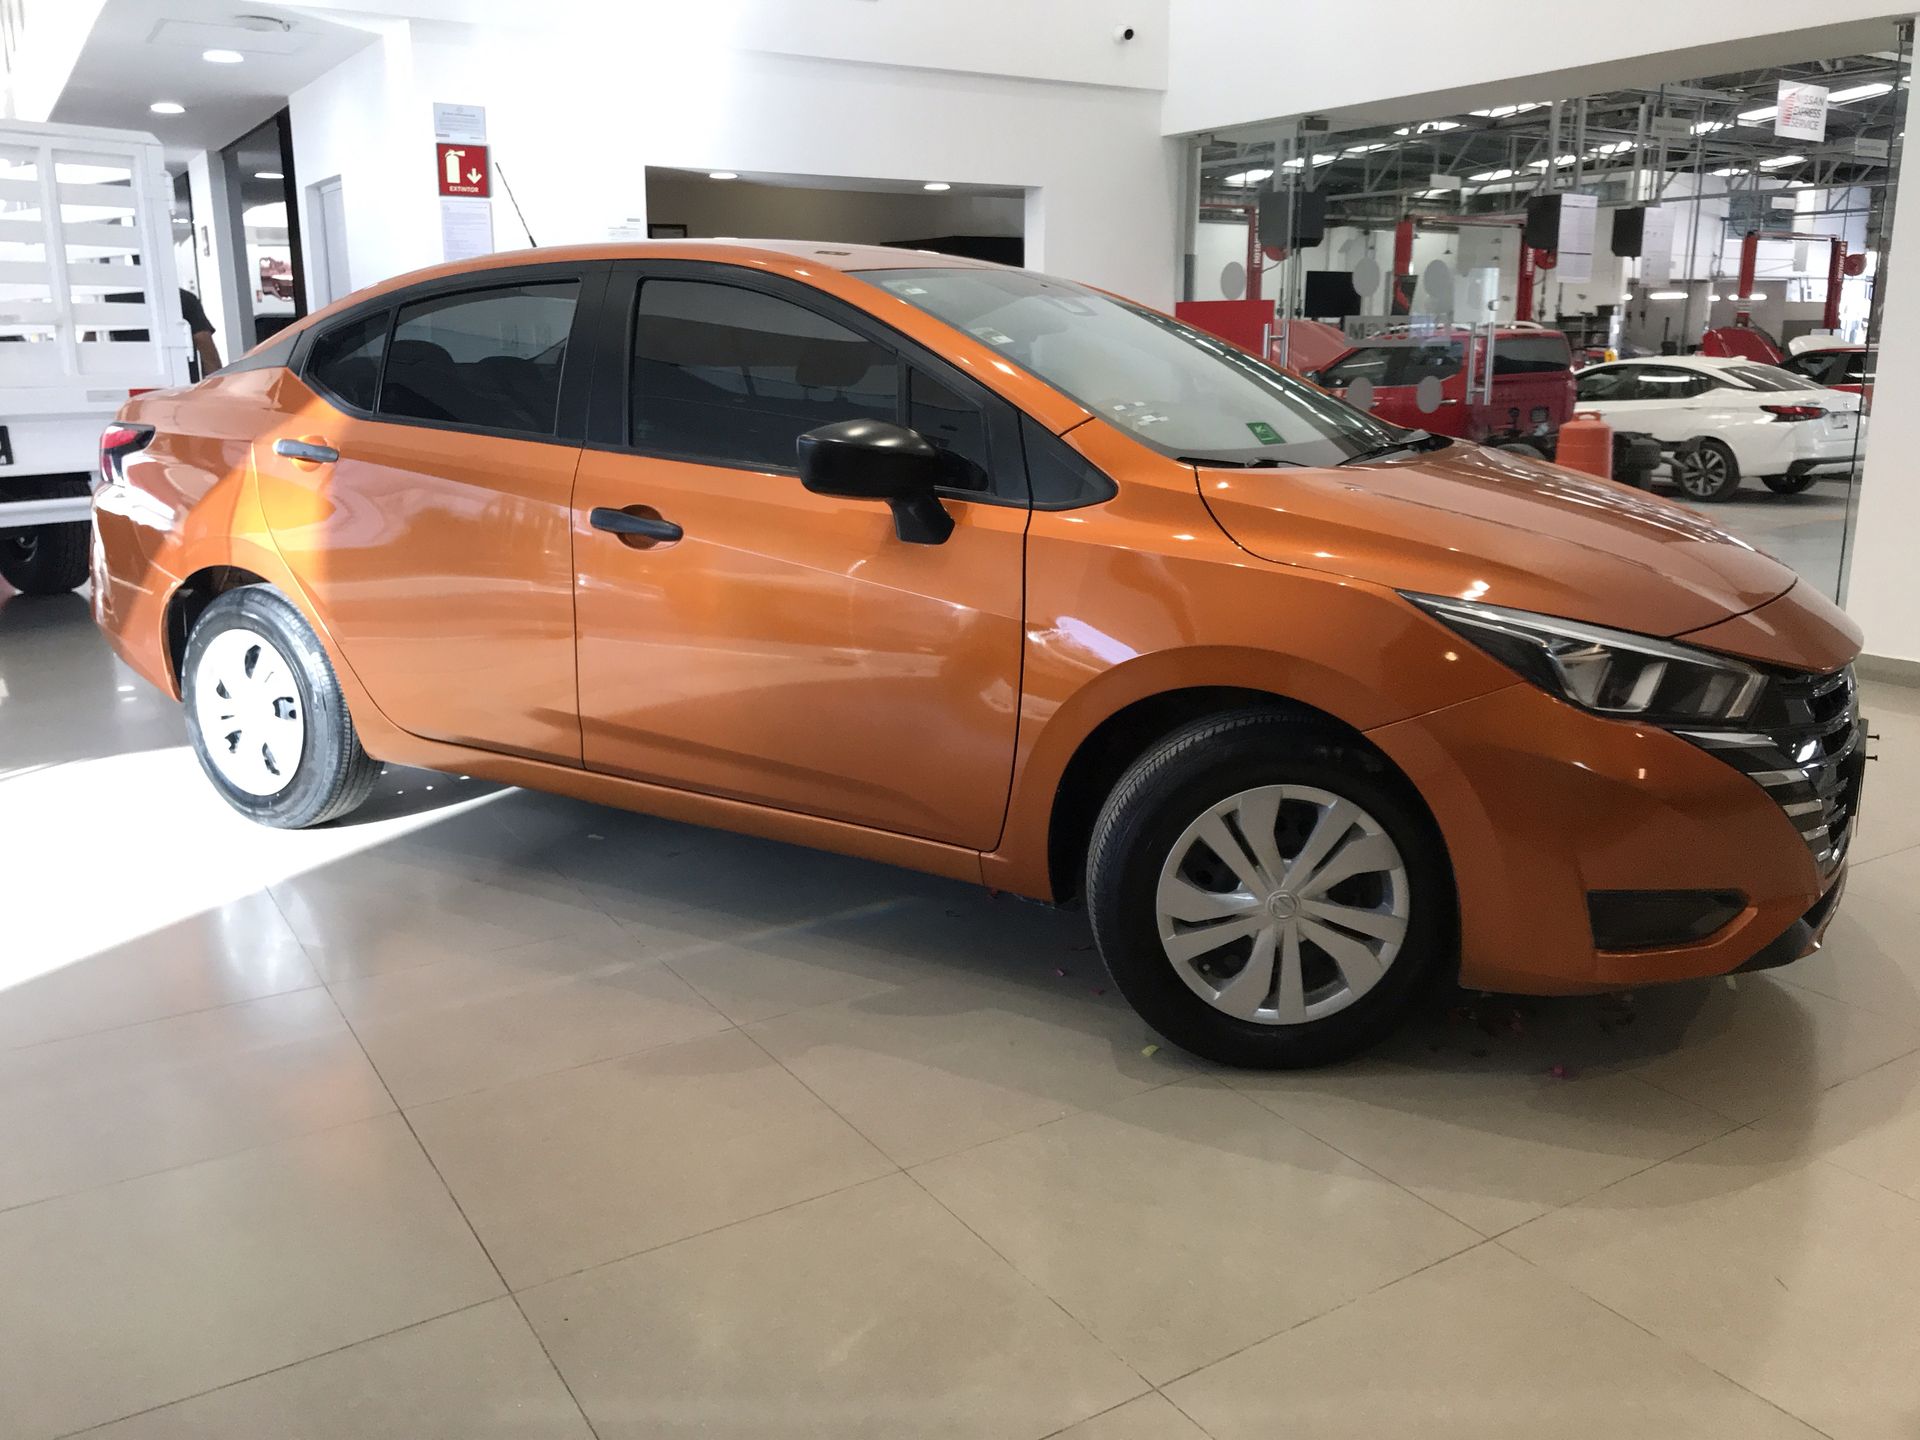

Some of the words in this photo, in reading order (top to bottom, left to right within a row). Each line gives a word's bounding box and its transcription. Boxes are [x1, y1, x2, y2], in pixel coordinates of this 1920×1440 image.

[1793, 105, 1822, 118] EXPRESS
[1790, 117, 1819, 130] SERVICE
[449, 185, 479, 193] EXTINTOR
